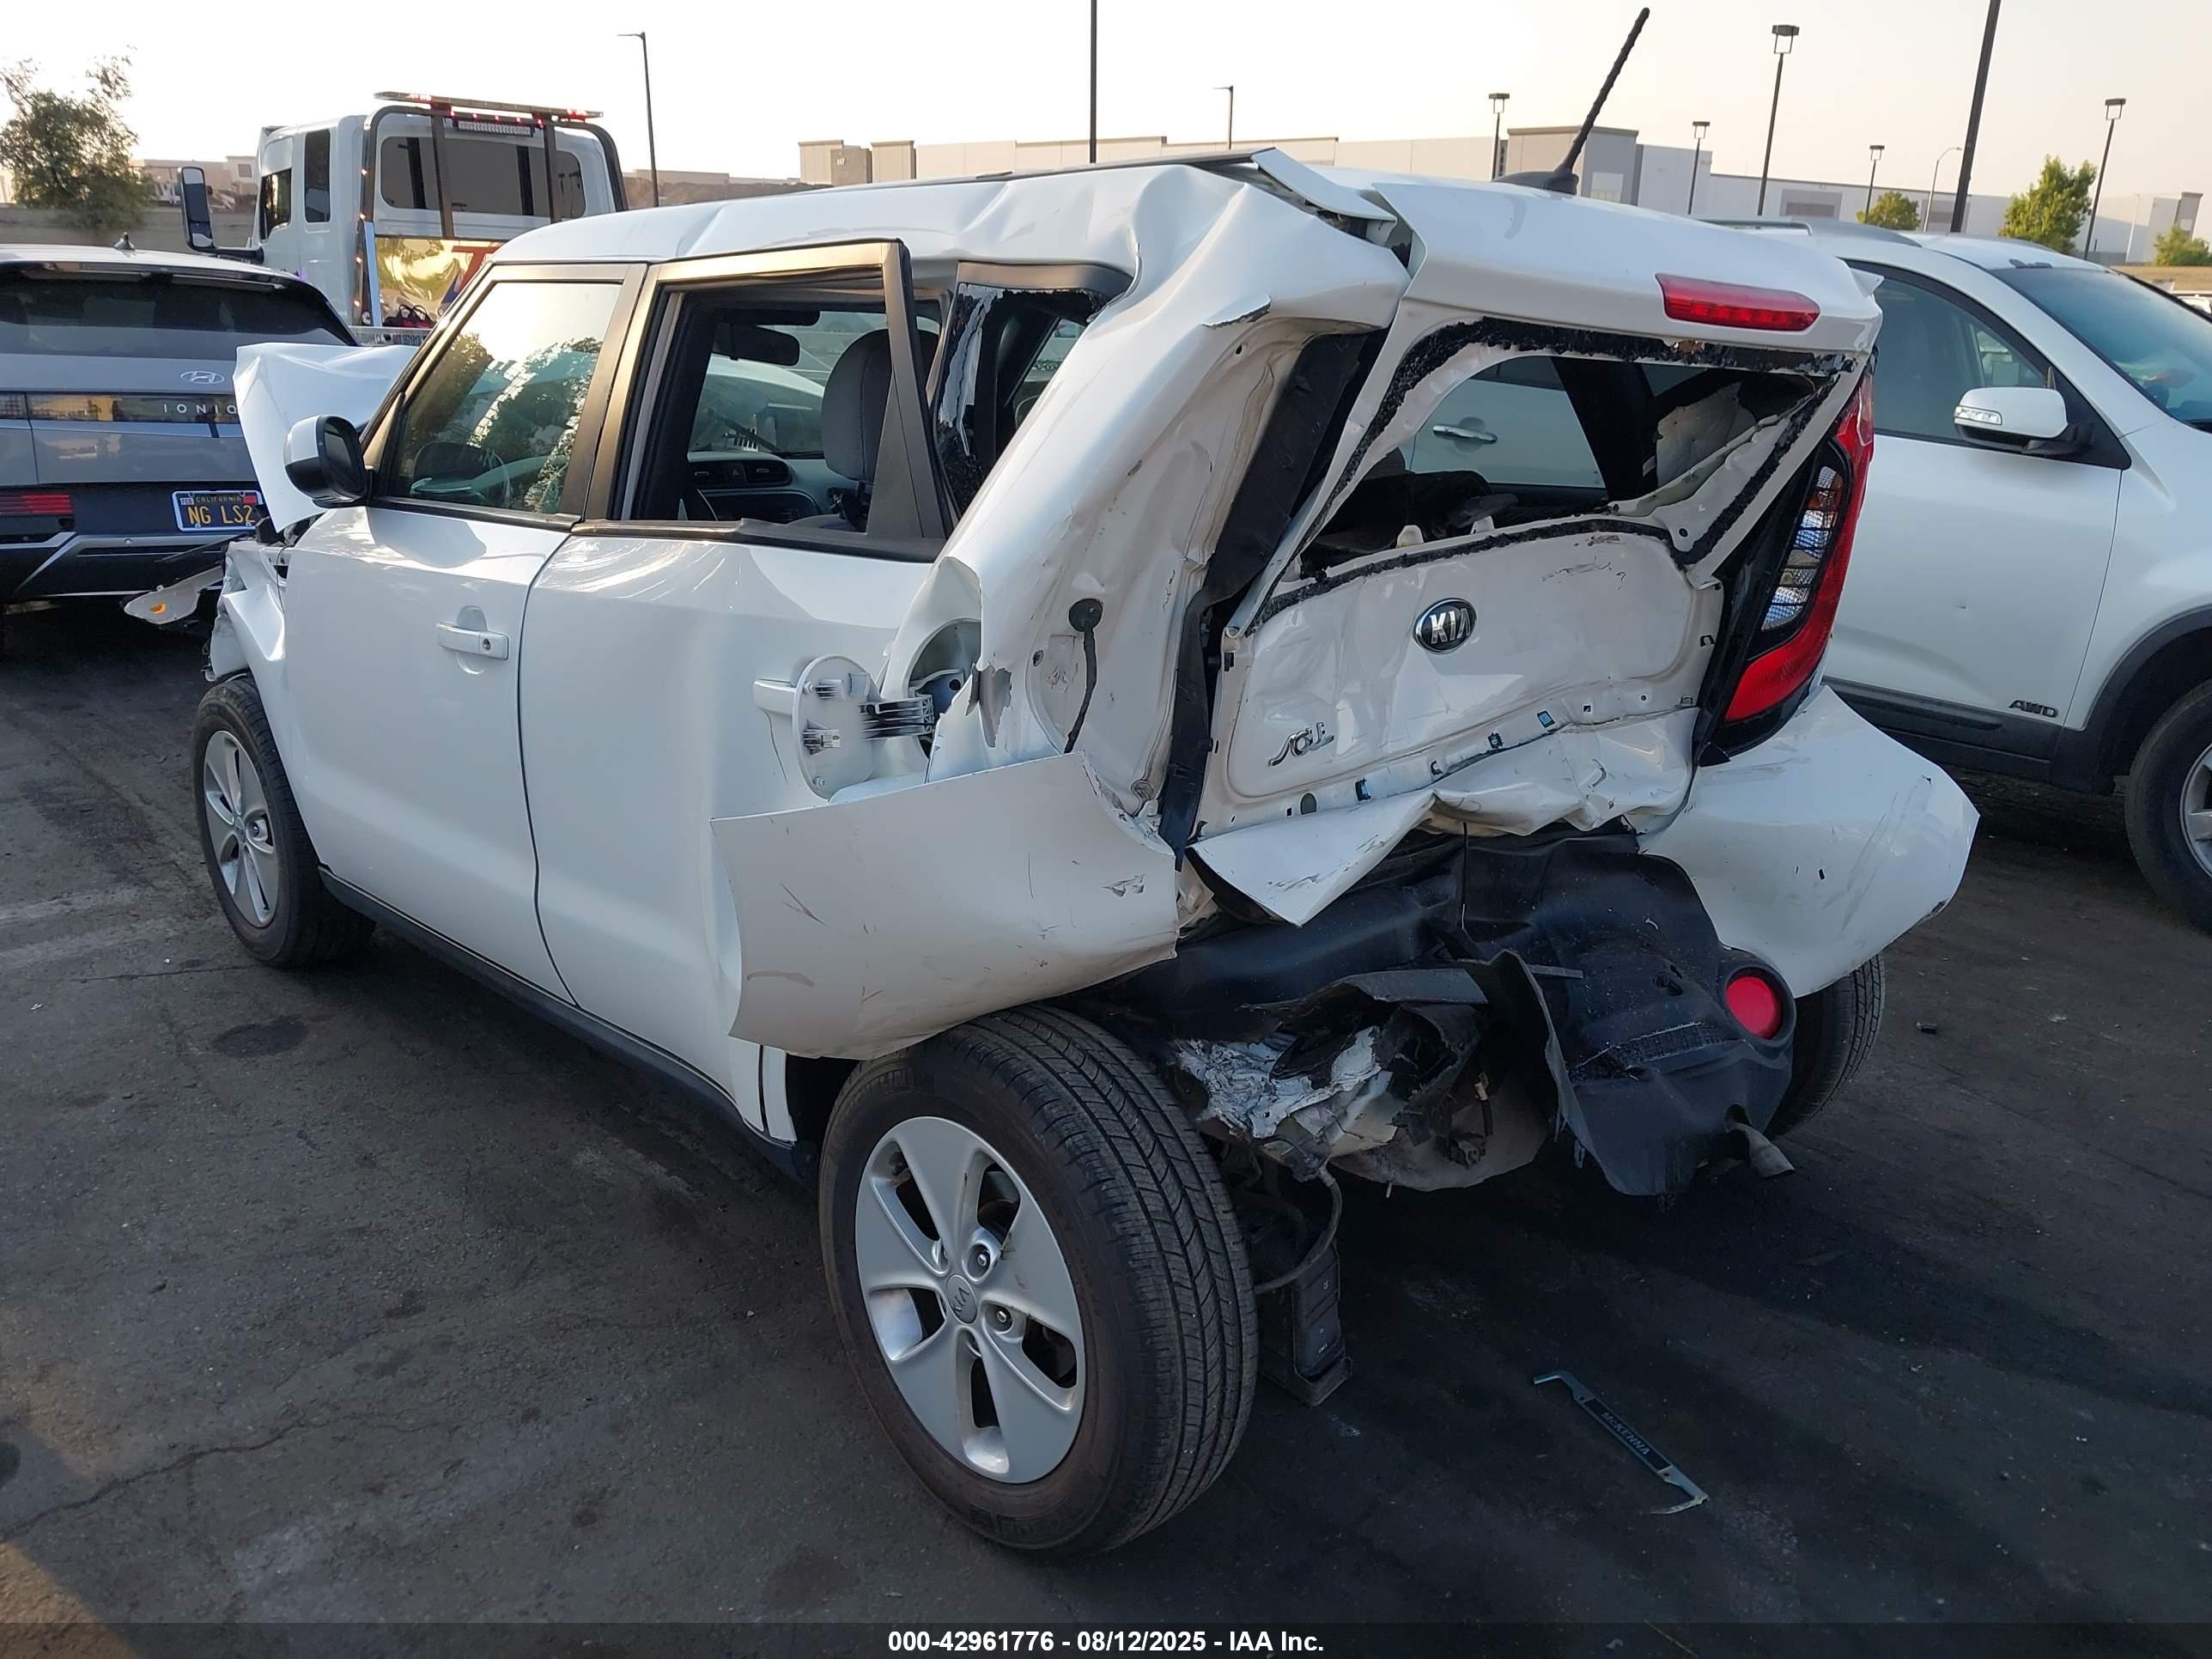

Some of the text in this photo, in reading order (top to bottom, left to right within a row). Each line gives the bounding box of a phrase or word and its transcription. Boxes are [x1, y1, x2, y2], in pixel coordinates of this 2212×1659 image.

[163, 404, 237, 414] IONIQ
[187, 505, 255, 525] NG LS2
[1430, 608, 1471, 644] KIA
[2008, 700, 2058, 719] AWD
[951, 1287, 970, 1313] KIA
